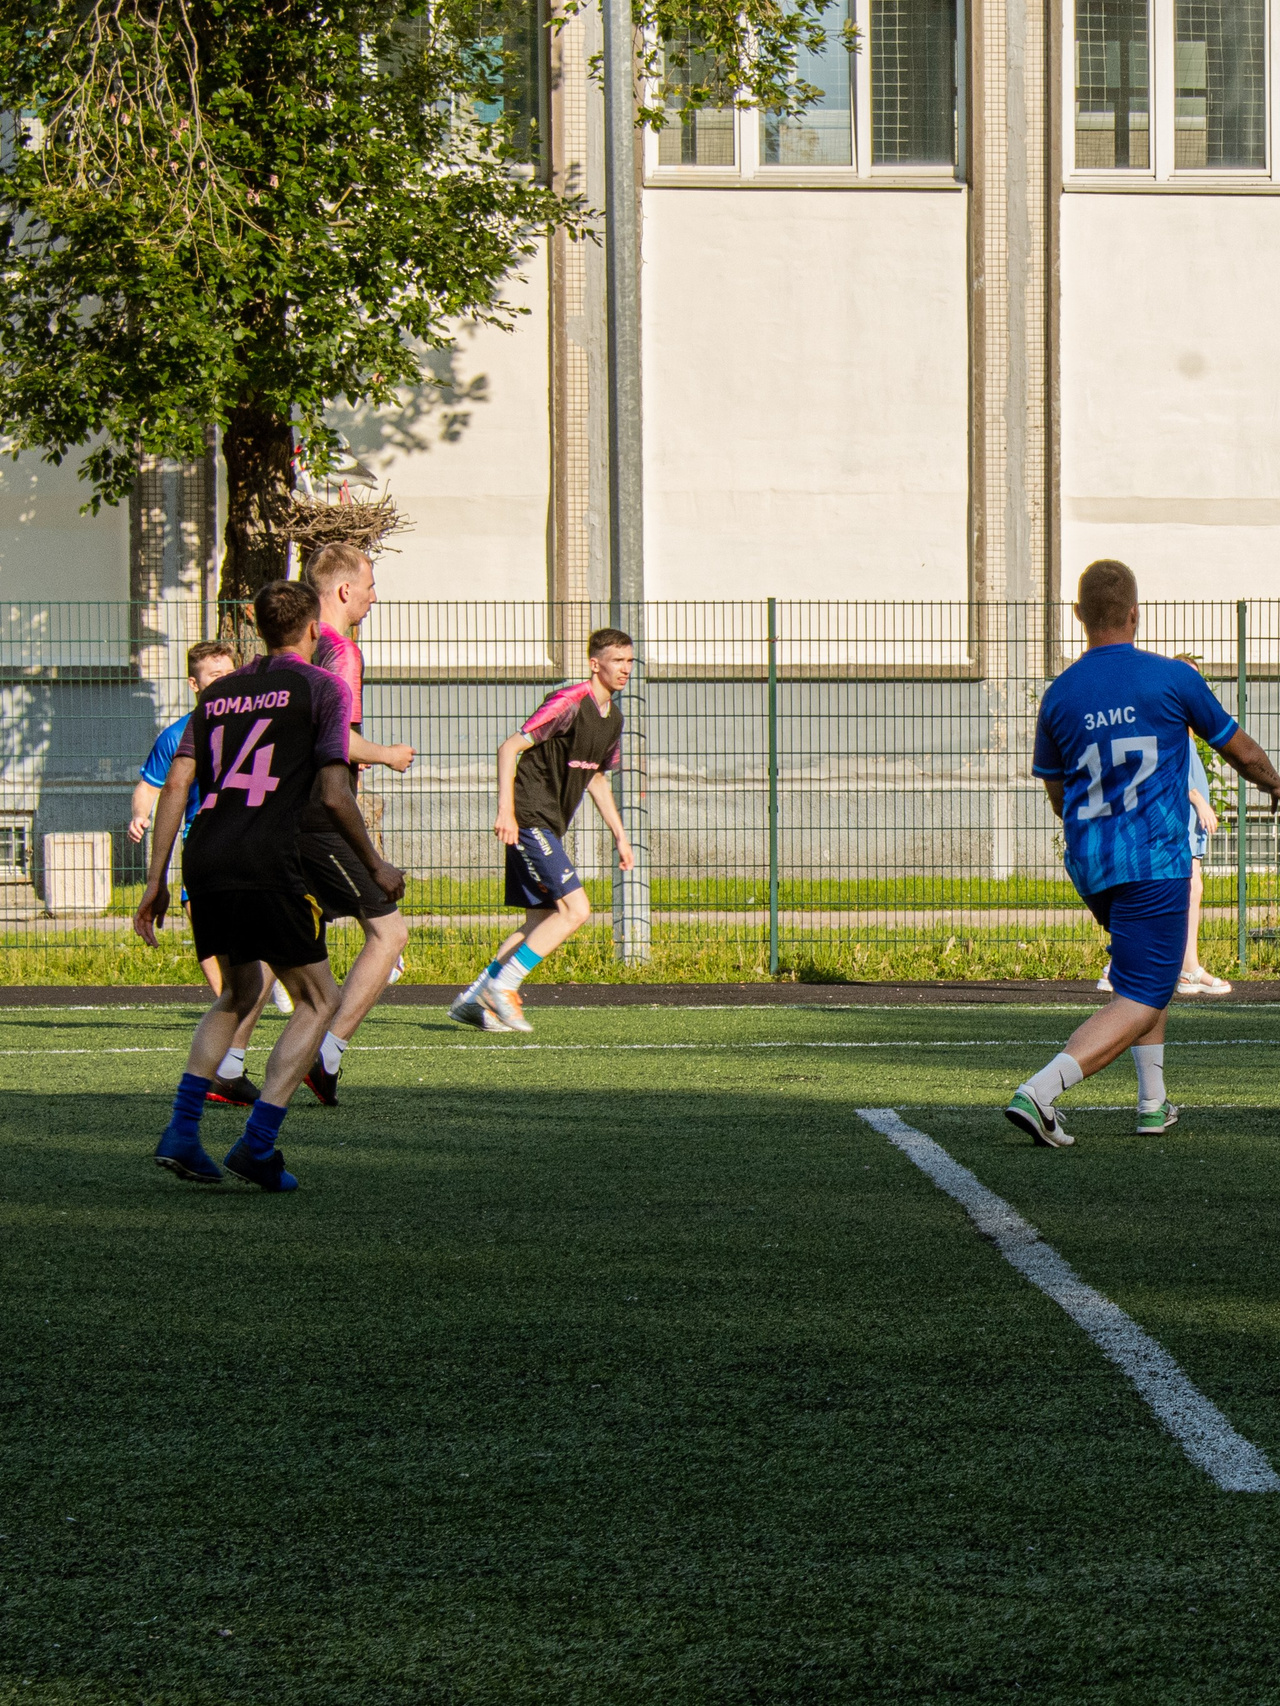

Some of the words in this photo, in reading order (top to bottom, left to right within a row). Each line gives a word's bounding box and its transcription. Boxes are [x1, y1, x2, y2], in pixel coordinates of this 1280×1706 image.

[205, 690, 291, 719] РОМАНОВ
[1084, 706, 1136, 730] ЗАИС
[197, 718, 280, 814] 14
[1076, 736, 1158, 820] 17
[530, 827, 553, 857] NISSA
